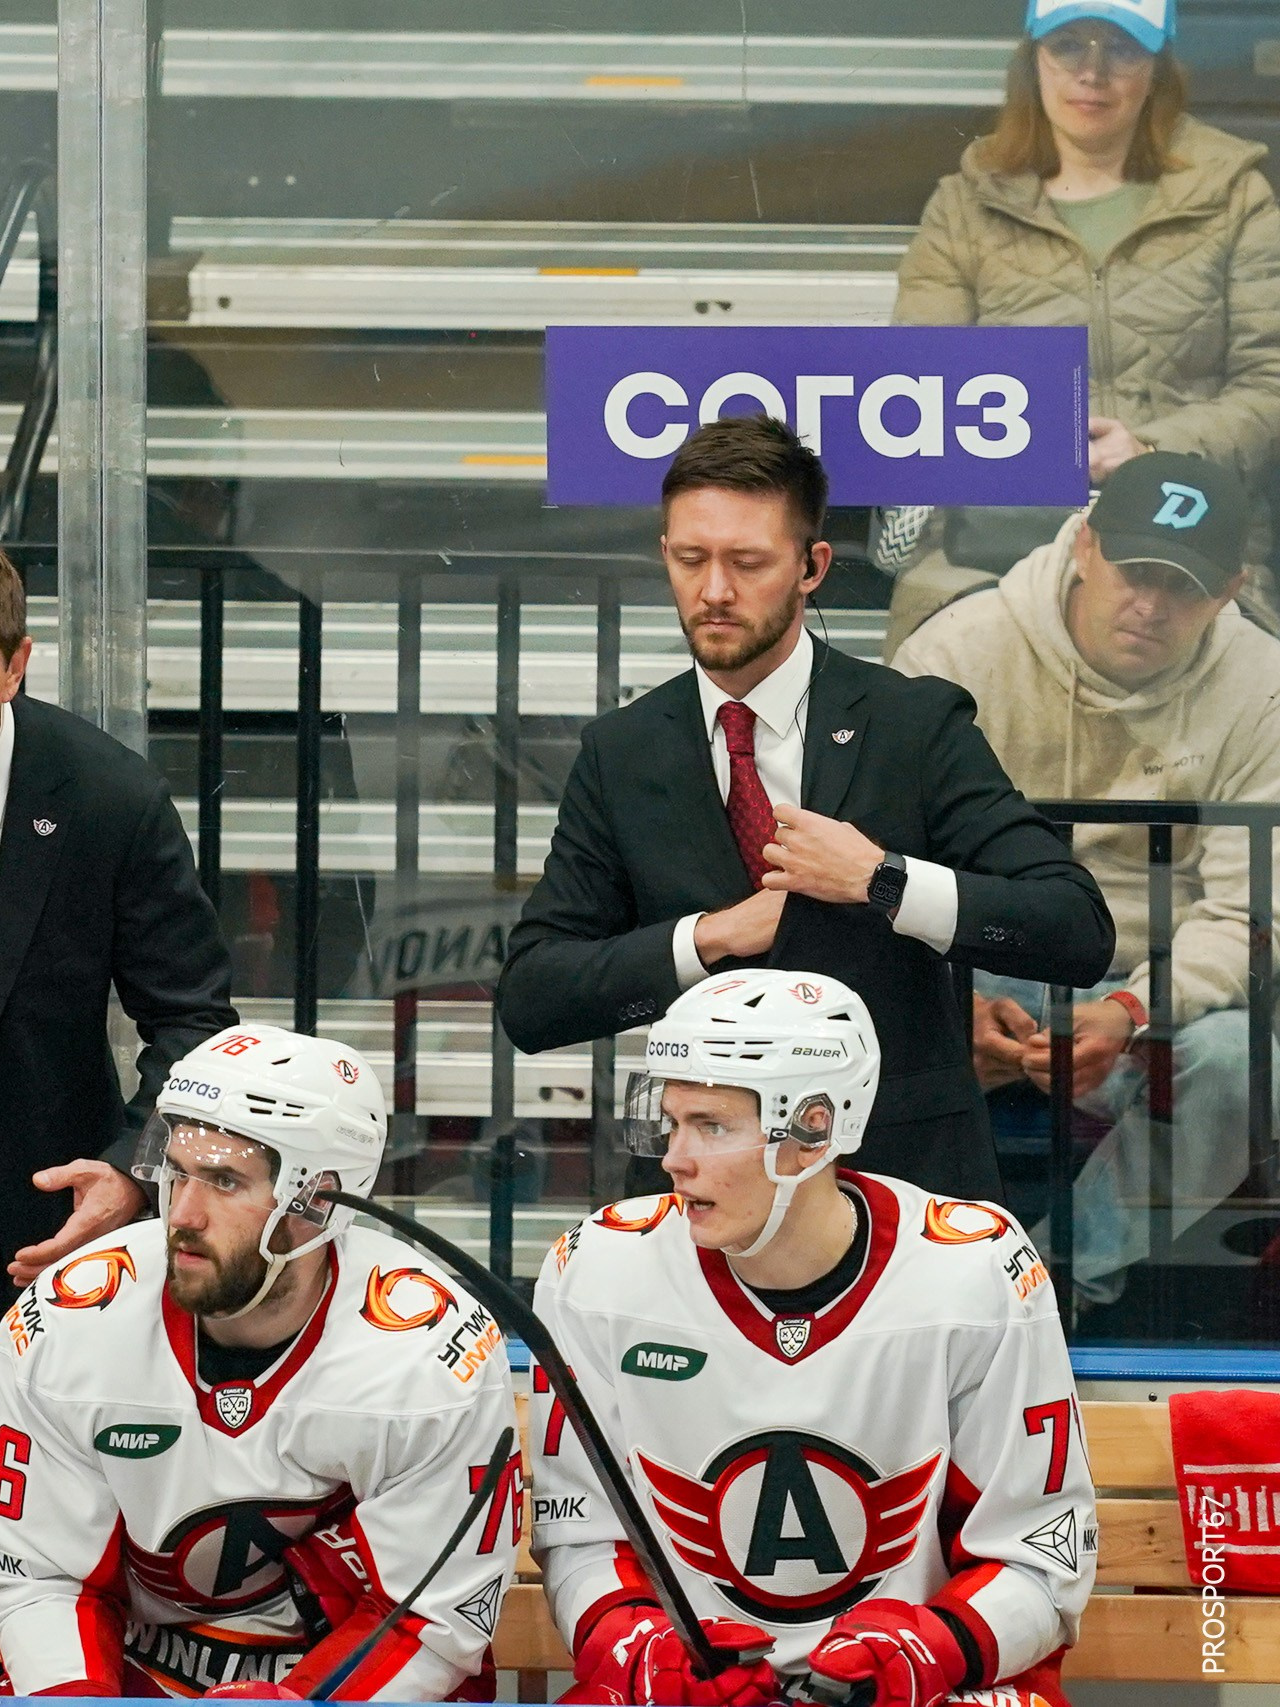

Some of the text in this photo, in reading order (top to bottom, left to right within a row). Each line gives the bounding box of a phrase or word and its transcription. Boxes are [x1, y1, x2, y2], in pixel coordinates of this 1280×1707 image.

[210, 1034, 261, 1056] 76
[648, 1040, 690, 1059] согаз
[168, 1076, 222, 1101] согаз
[1003, 1245, 1038, 1281] УГМ
[21, 1281, 45, 1342] ГМК
[437, 1304, 492, 1369] УГМК
[453, 1322, 501, 1383] UMMC
[636, 1350, 690, 1372] МИР
[108, 1431, 161, 1450] МИР
[534, 1496, 587, 1522] РМК
